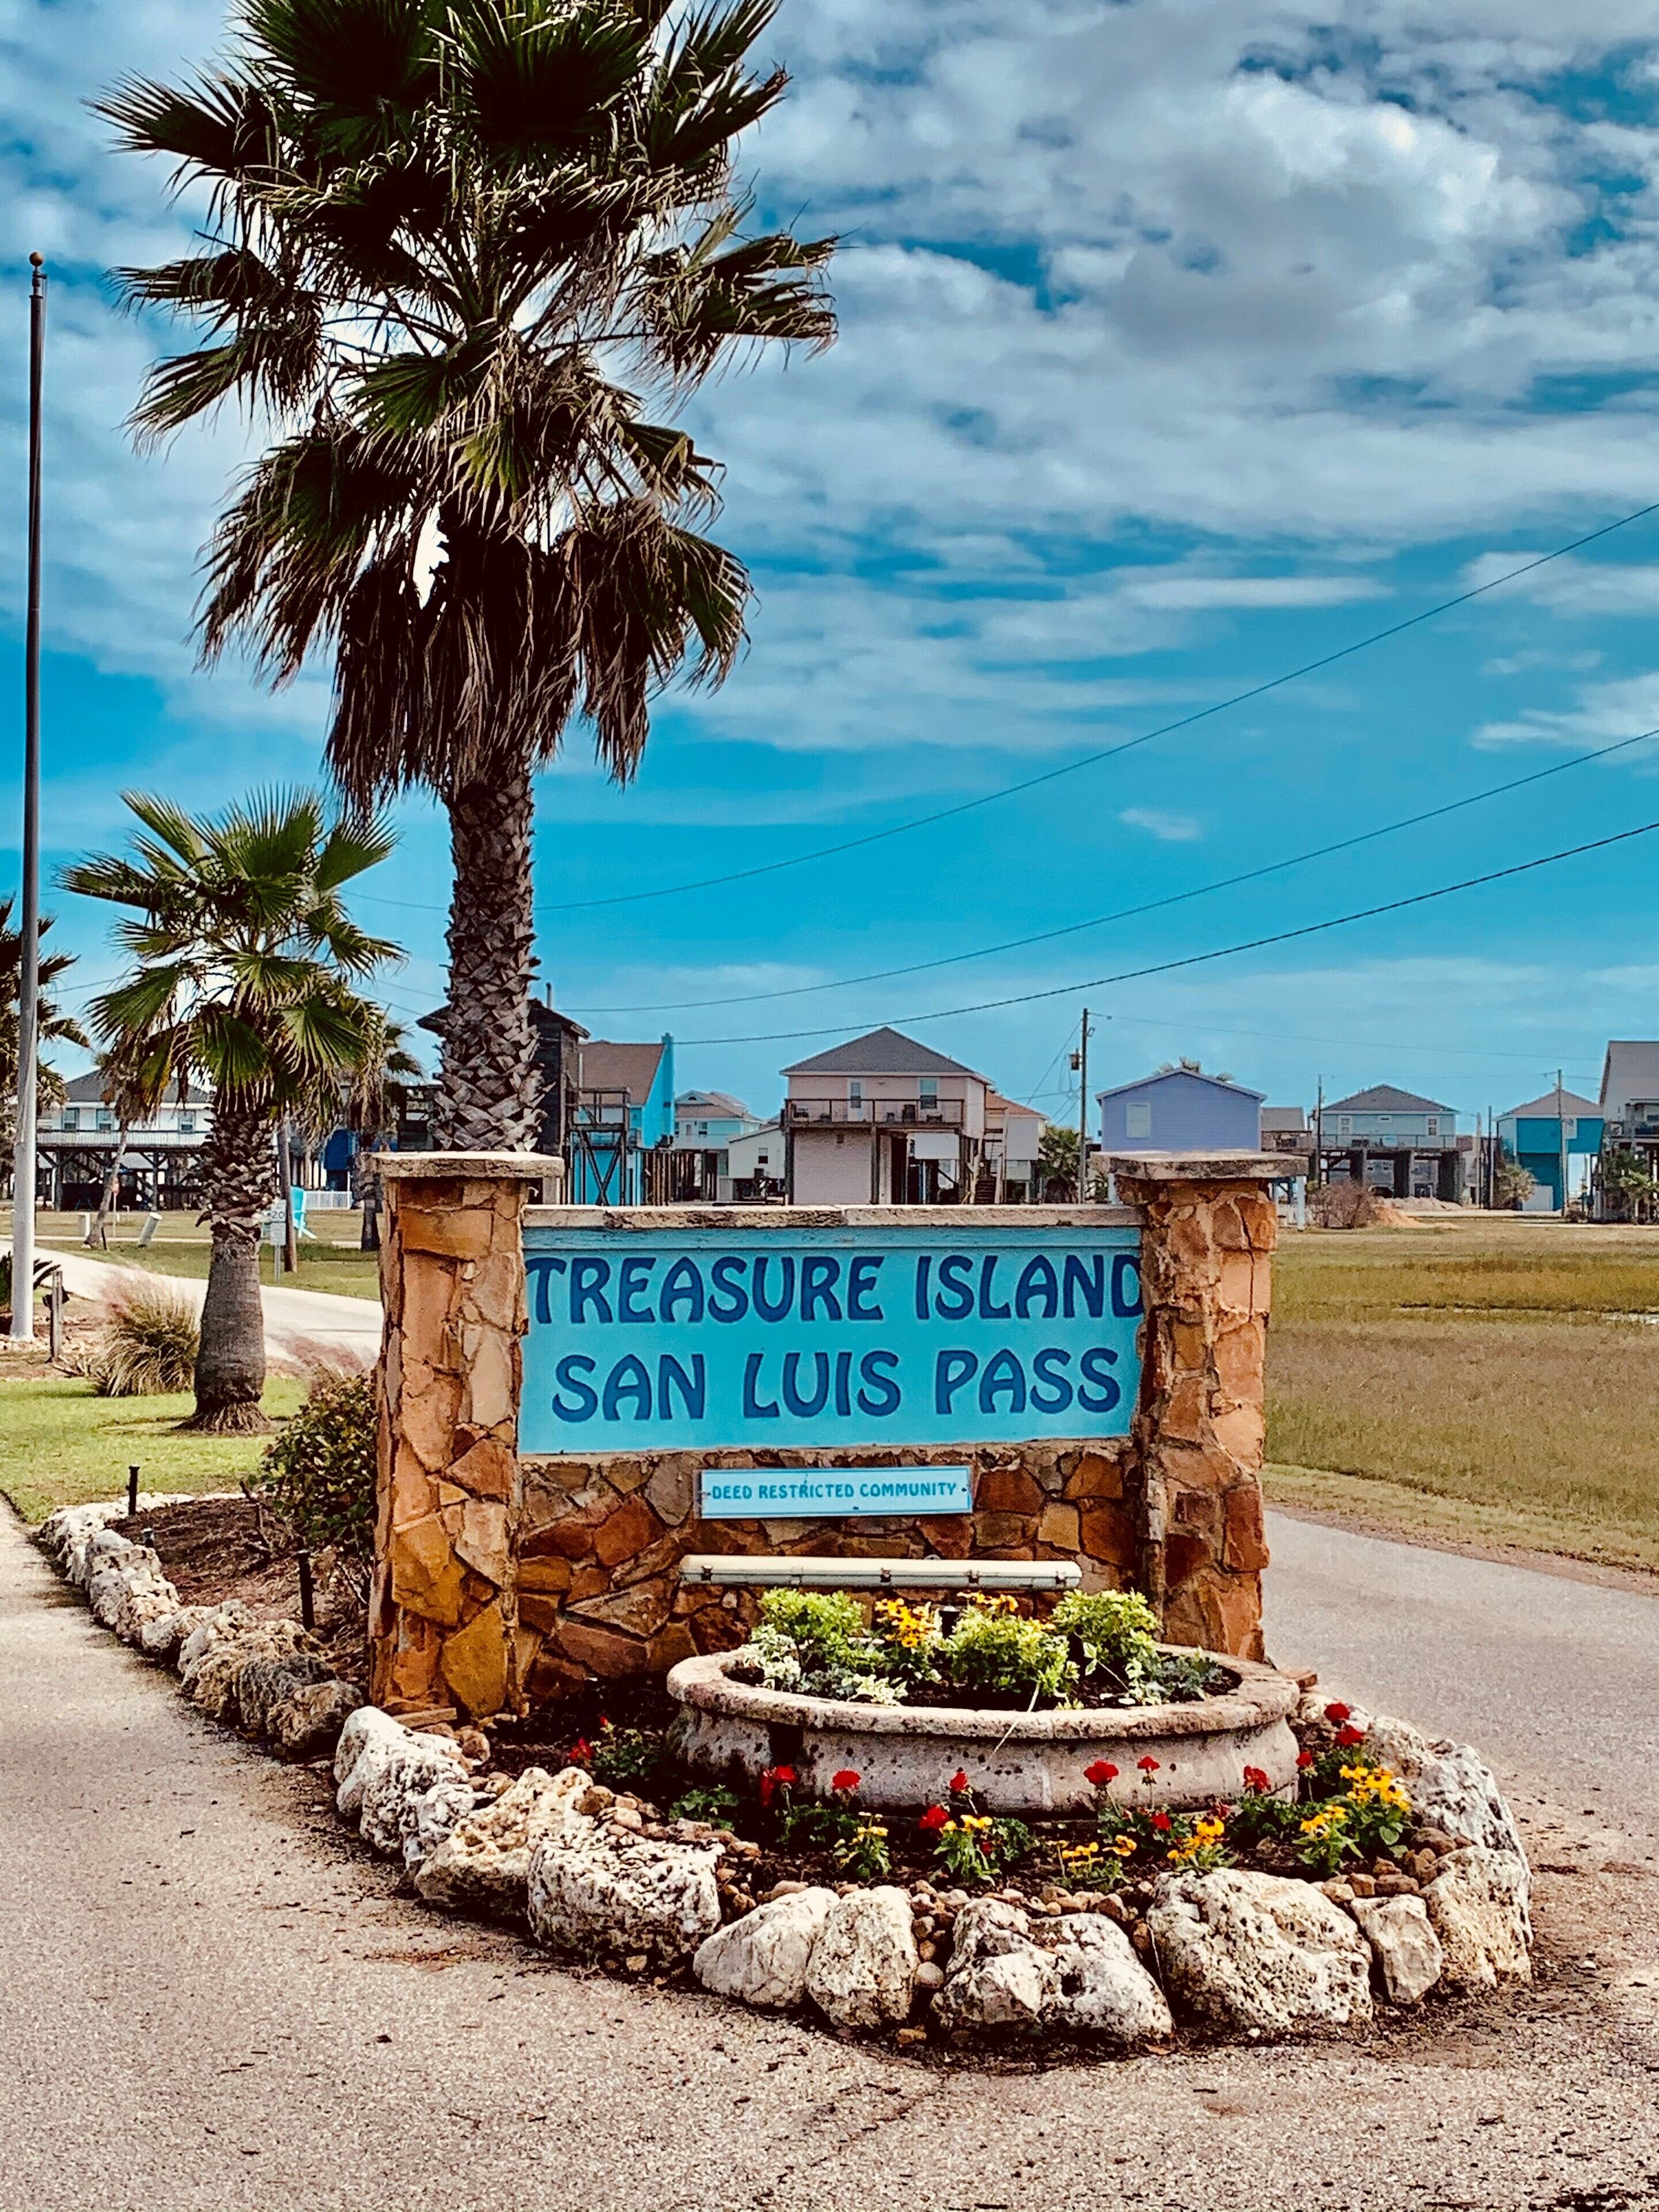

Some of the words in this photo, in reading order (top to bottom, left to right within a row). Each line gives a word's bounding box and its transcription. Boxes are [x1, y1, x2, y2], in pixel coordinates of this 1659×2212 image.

[525, 1256, 885, 1324] TREASURE
[915, 1254, 1144, 1320] ISLAND
[552, 1354, 705, 1423] SAN
[743, 1350, 901, 1418] LUIS
[935, 1347, 1121, 1414] PASS
[712, 1484, 753, 1499] DEED
[759, 1483, 854, 1499] RESTRICTED
[859, 1482, 957, 1497] COMMUNITY
